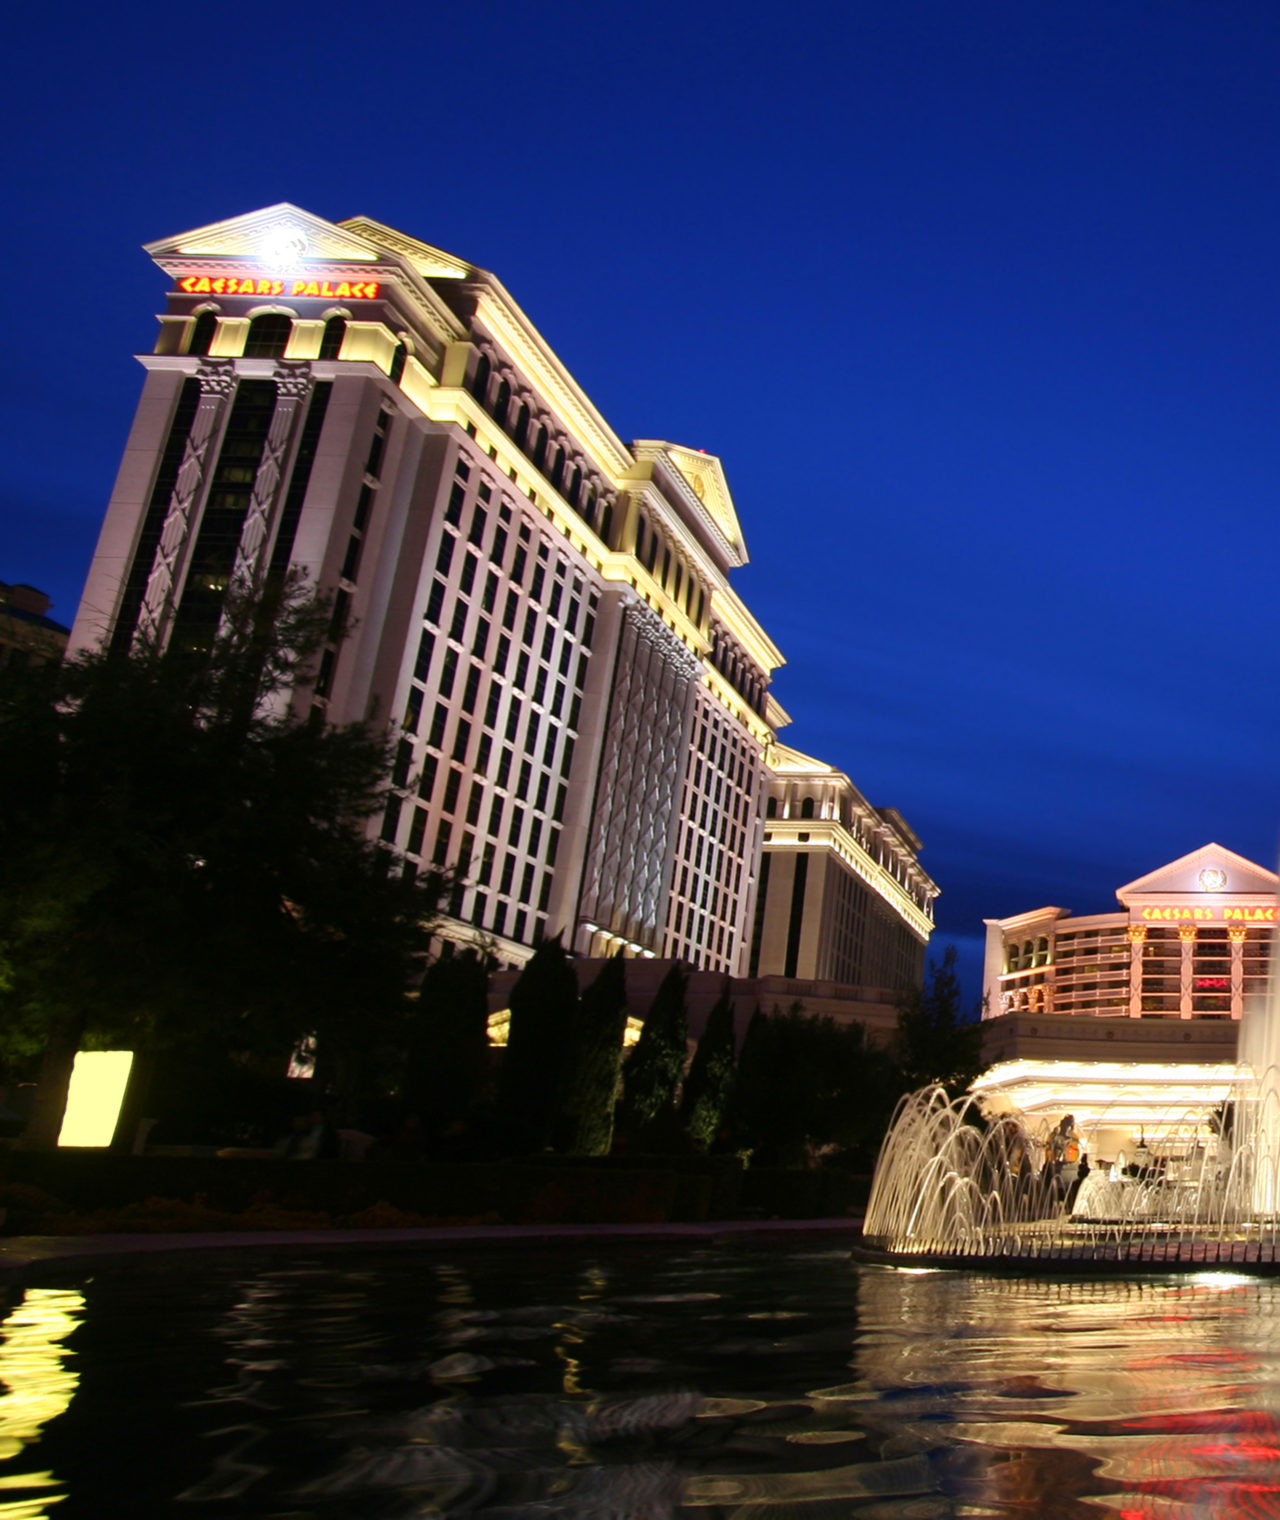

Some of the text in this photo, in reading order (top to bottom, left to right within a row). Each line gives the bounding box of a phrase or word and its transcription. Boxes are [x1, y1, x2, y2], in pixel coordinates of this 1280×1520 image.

[180, 276, 380, 300] CAESARS PALACE
[1141, 907, 1214, 921] CAESARS
